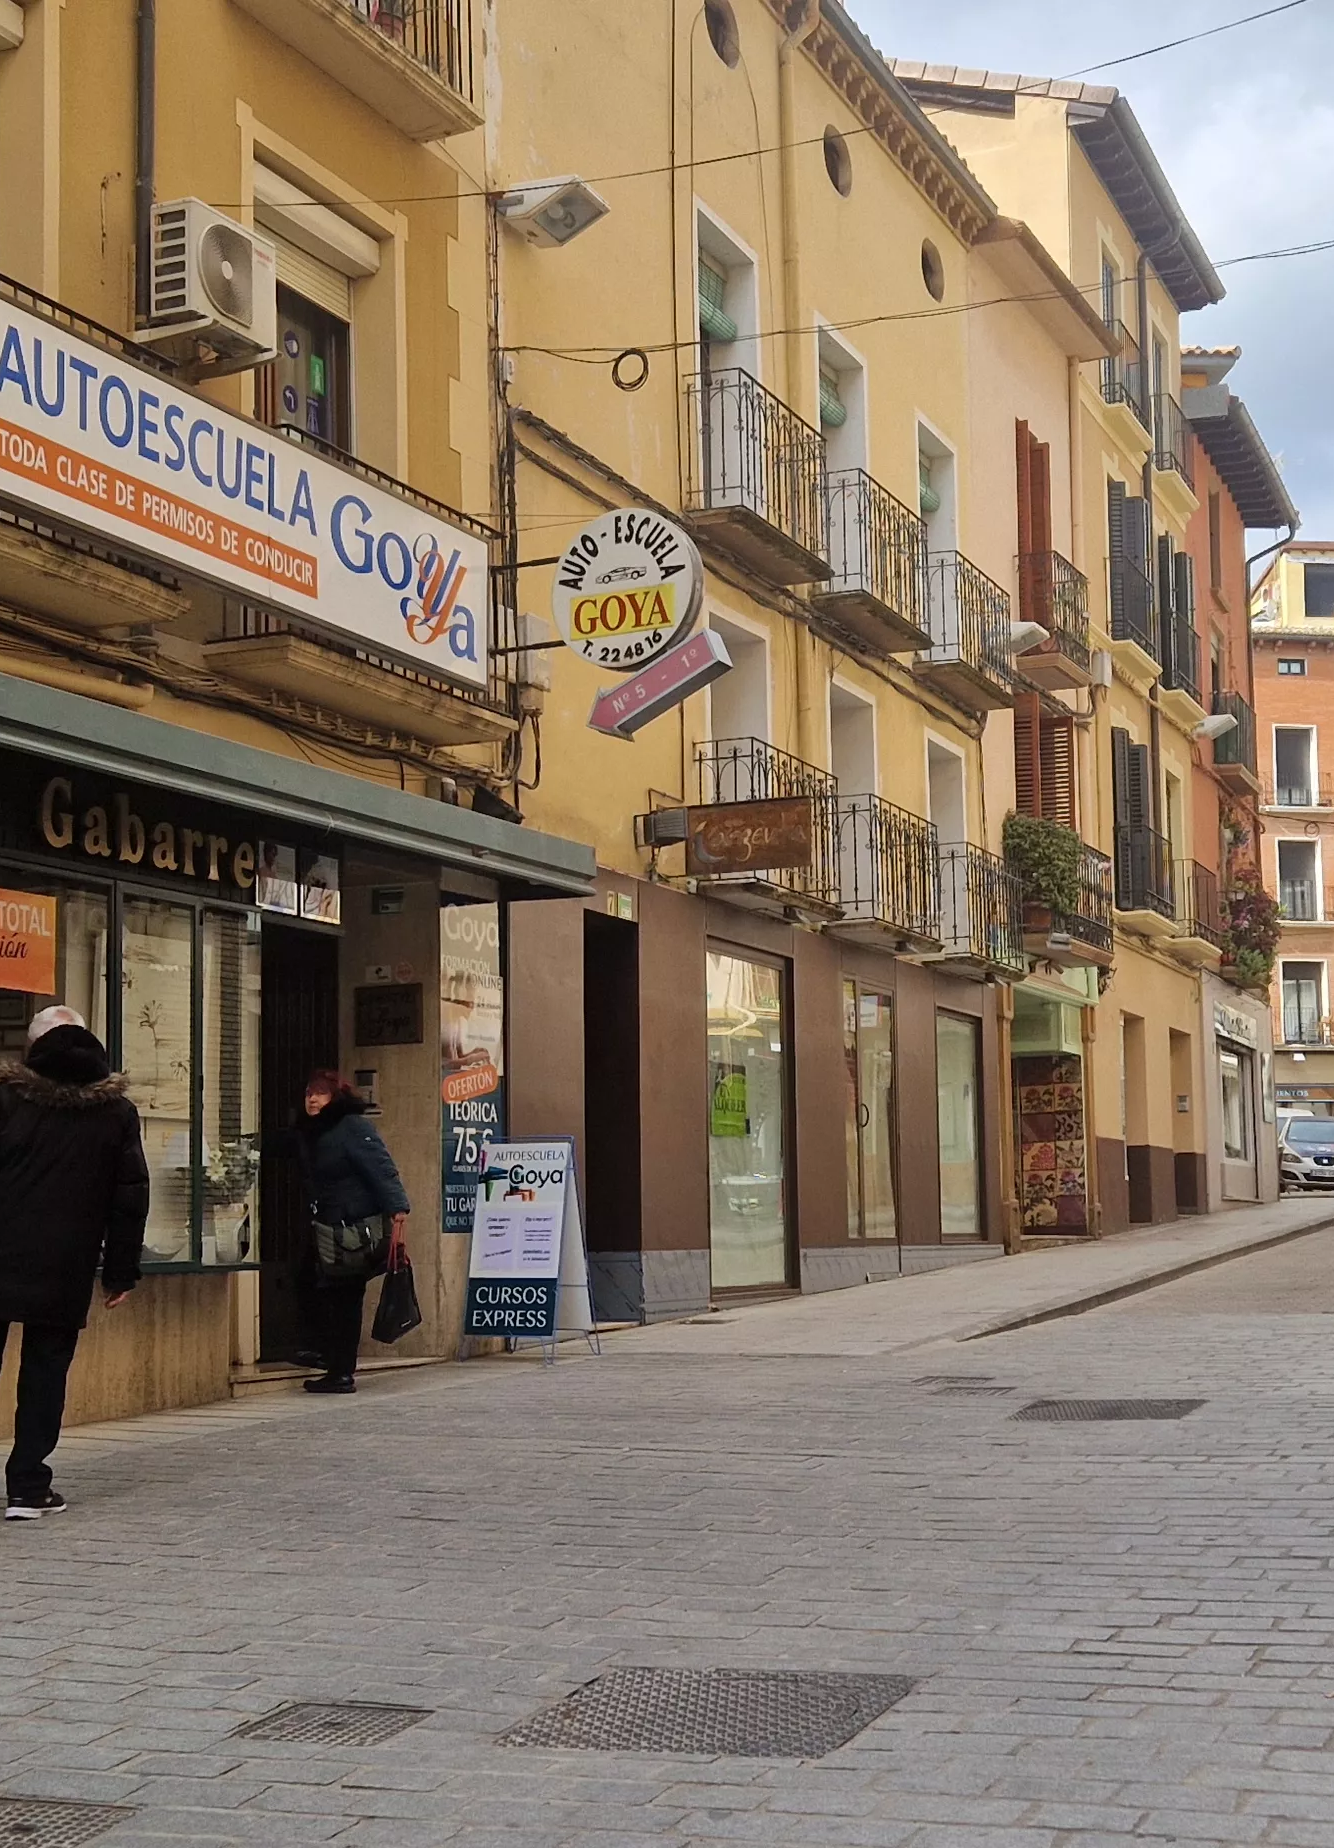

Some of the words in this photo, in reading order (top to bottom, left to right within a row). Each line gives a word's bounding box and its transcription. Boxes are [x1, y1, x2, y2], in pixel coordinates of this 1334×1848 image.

[56, 454, 108, 500] CLASE
[115, 479, 136, 512] DE
[143, 490, 215, 545] PERMISOS
[220, 526, 239, 556] DE
[244, 538, 314, 588] CONDUCIR
[614, 513, 687, 581] ESCUELA
[330, 494, 478, 663] Goya
[573, 590, 672, 636] GOYA
[634, 683, 647, 700] 5
[41, 776, 255, 889] Gabarre
[440, 954, 491, 976] FORMACIÓN
[471, 973, 502, 991] ONLINE
[447, 1067, 494, 1099] OFERTÓN
[494, 1150, 565, 1162] AUTOESCUELA
[509, 1164, 564, 1188] Goya
[446, 1197, 457, 1212] TU
[445, 1215, 457, 1228] QUE
[458, 1216, 468, 1227] NO
[475, 1286, 547, 1304] CURSOS
[472, 1310, 547, 1328] EXPRESS
